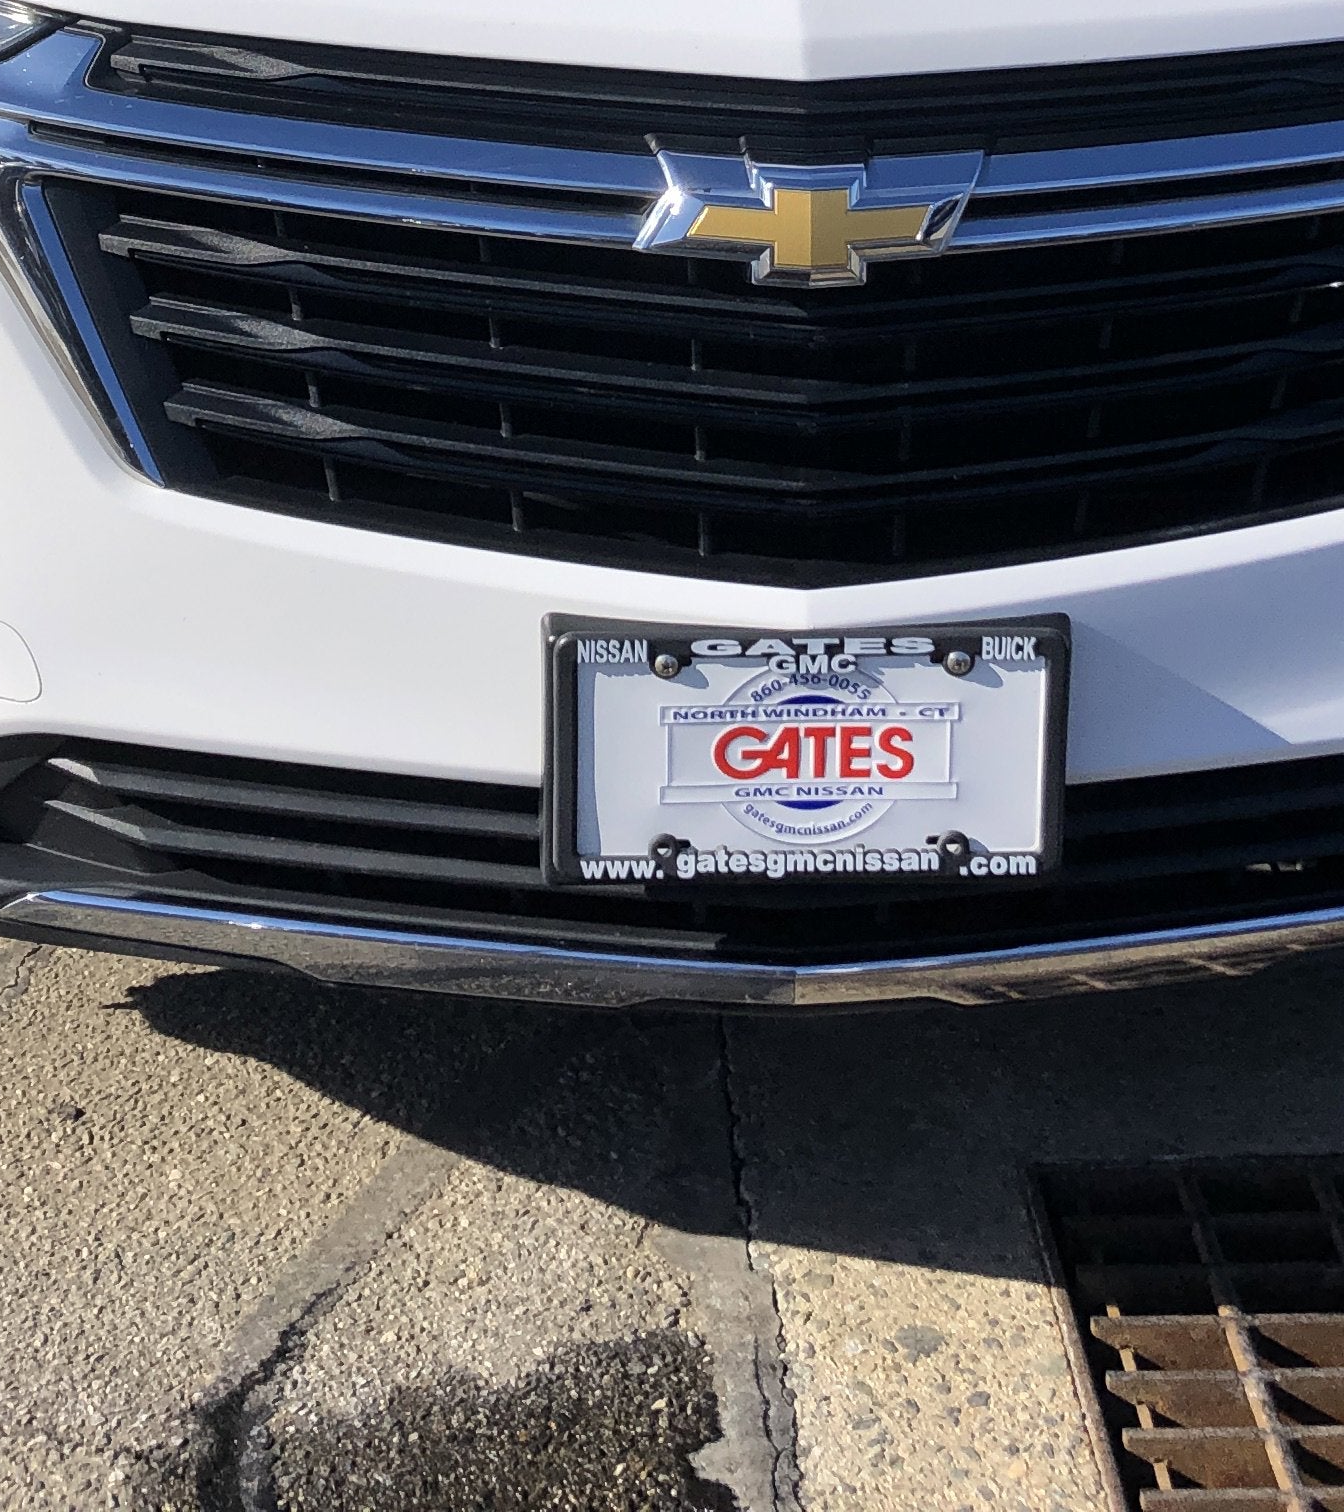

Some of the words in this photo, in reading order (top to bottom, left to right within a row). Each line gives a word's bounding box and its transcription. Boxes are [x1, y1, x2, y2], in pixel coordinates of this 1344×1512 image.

[577, 638, 648, 664] NISSAN
[690, 636, 936, 656] GATES
[981, 635, 1037, 661] BUICK
[768, 653, 857, 675] GMC
[750, 673, 873, 703] 860-456-0055
[672, 708, 756, 721] NORTH
[762, 707, 887, 719] WINDHAM
[918, 706, 950, 718] CT
[713, 725, 915, 780] GATES
[734, 786, 790, 798] GMC
[795, 785, 885, 797] NISSAN
[743, 801, 874, 836] gatesgmcnissan.com
